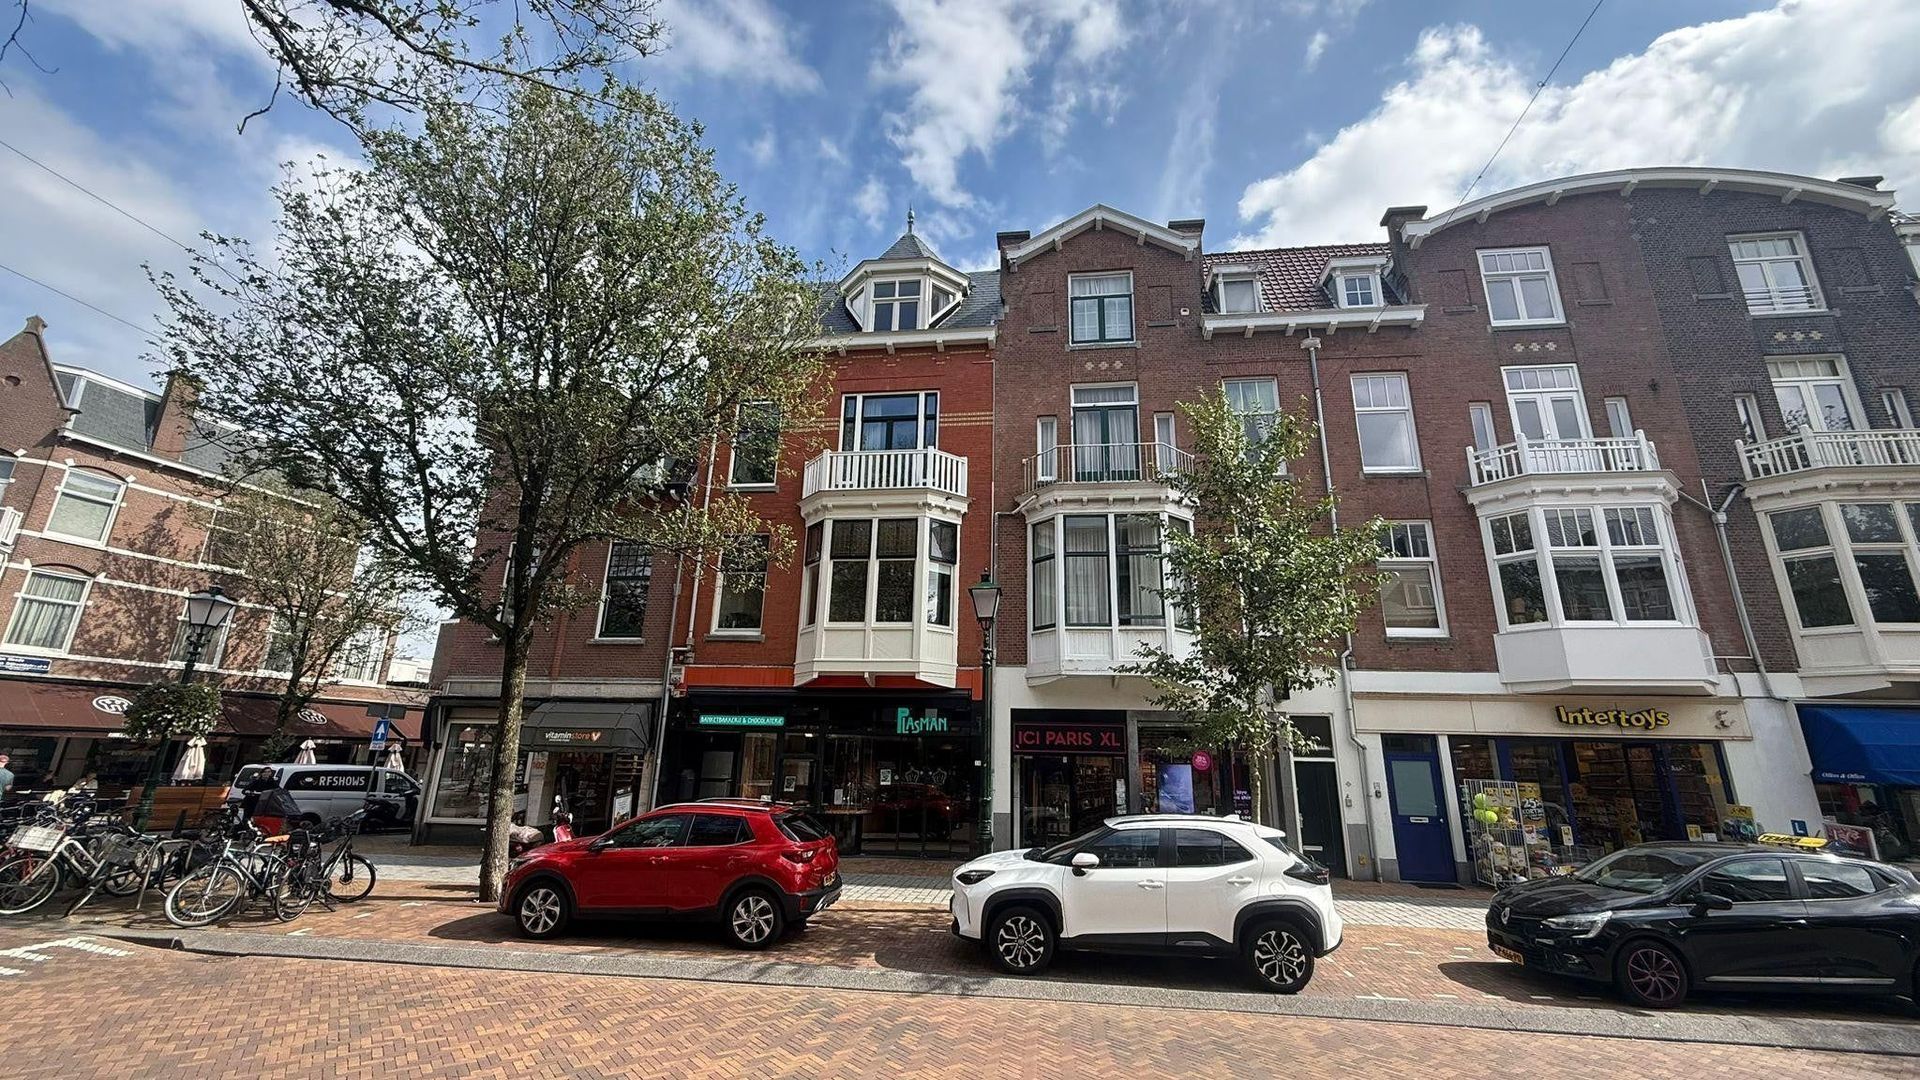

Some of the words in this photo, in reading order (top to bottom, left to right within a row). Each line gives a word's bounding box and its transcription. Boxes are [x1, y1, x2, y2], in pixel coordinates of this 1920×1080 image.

[1556, 705, 1670, 730] Intertoys
[545, 731, 591, 741] vitaminstore
[1018, 731, 1040, 745] ICI
[1046, 731, 1093, 746] PARIS
[1100, 732, 1121, 747] XL
[319, 776, 366, 786] RFSHOWS
